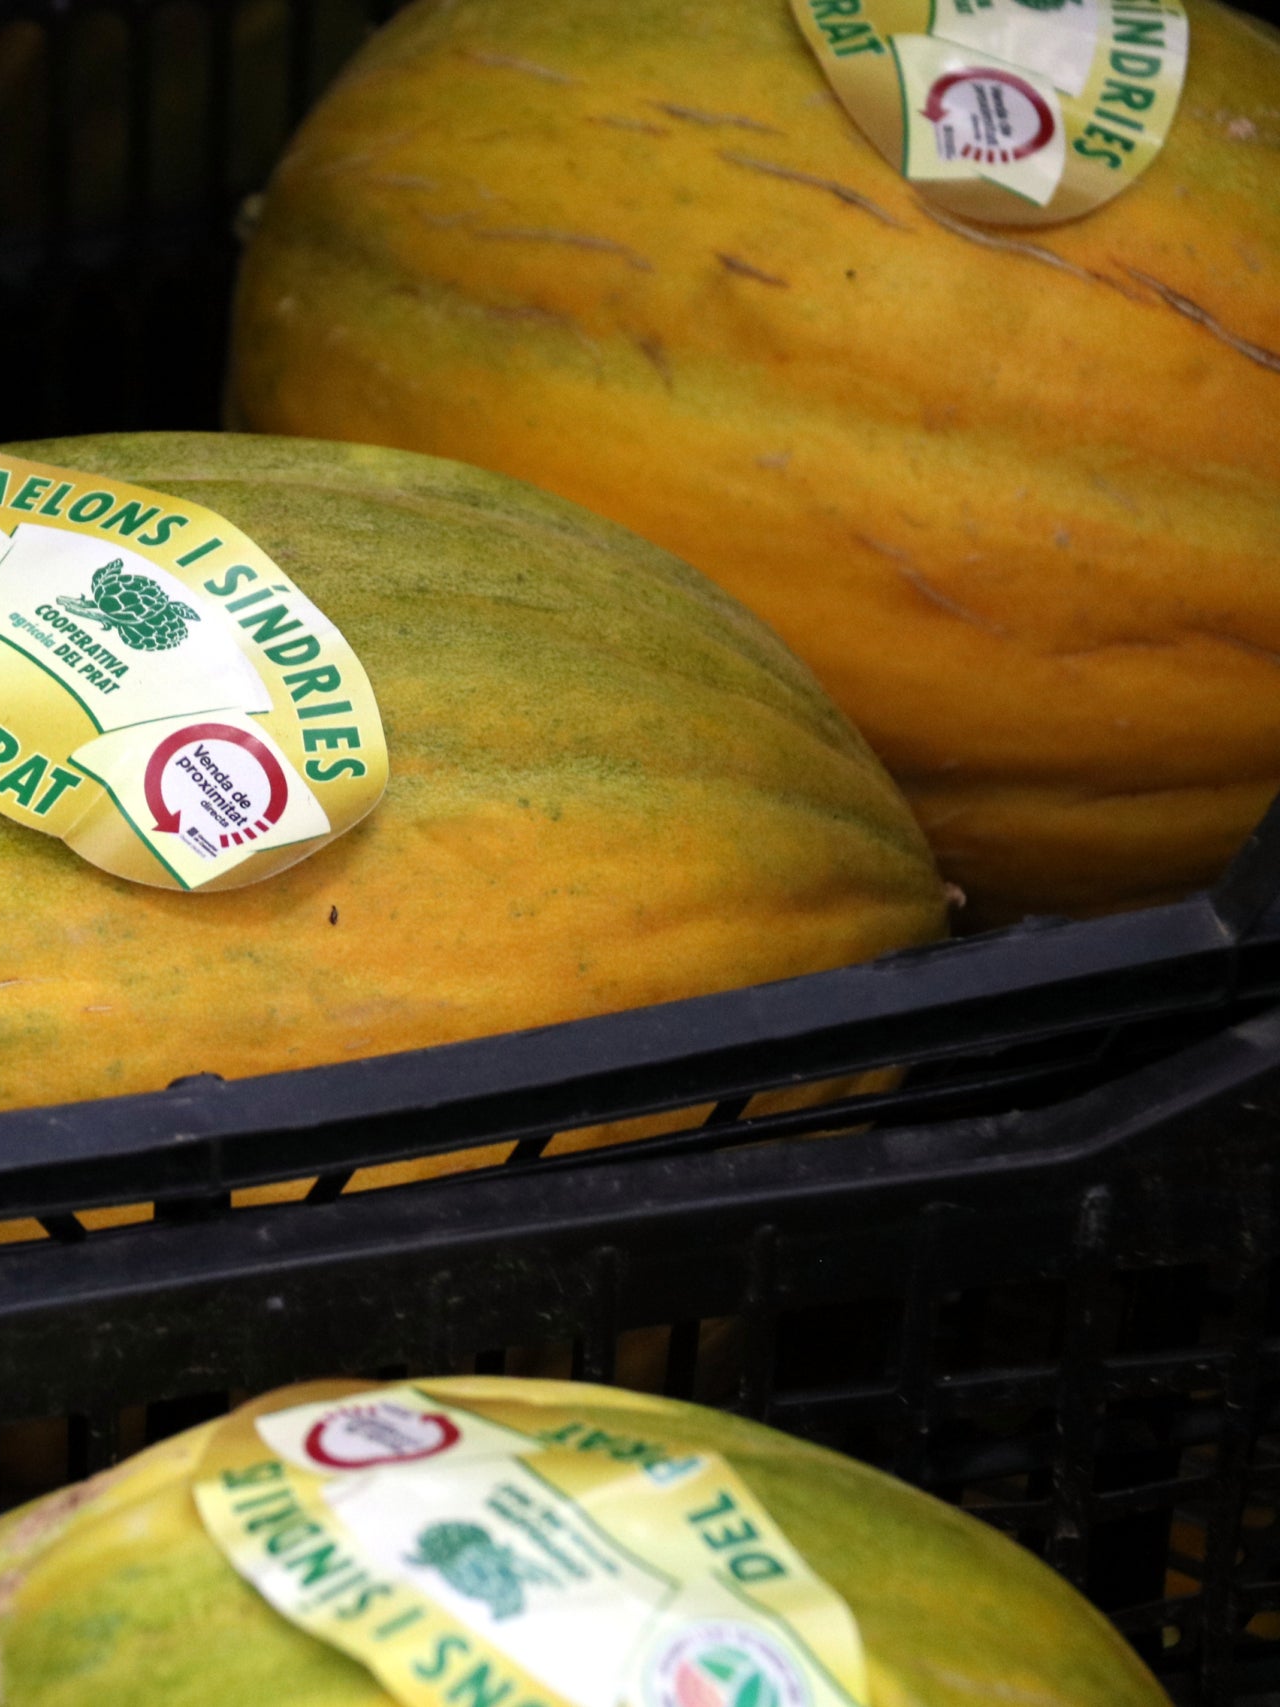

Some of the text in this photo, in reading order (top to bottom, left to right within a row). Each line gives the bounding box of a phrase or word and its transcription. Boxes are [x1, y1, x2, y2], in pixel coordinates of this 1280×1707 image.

[1072, 0, 1179, 169] ÍNDRIES
[34, 604, 130, 679] COOPERATIVA
[52, 643, 84, 668] DEL
[77, 663, 121, 695] PRAT
[175, 537, 224, 568] I
[203, 564, 368, 784] SÍNDRIES
[175, 756, 248, 827] proximitat
[193, 743, 251, 810] Venda de
[200, 799, 230, 828] directa
[687, 1489, 787, 1582] DEL
[415, 1635, 549, 1707] NS
